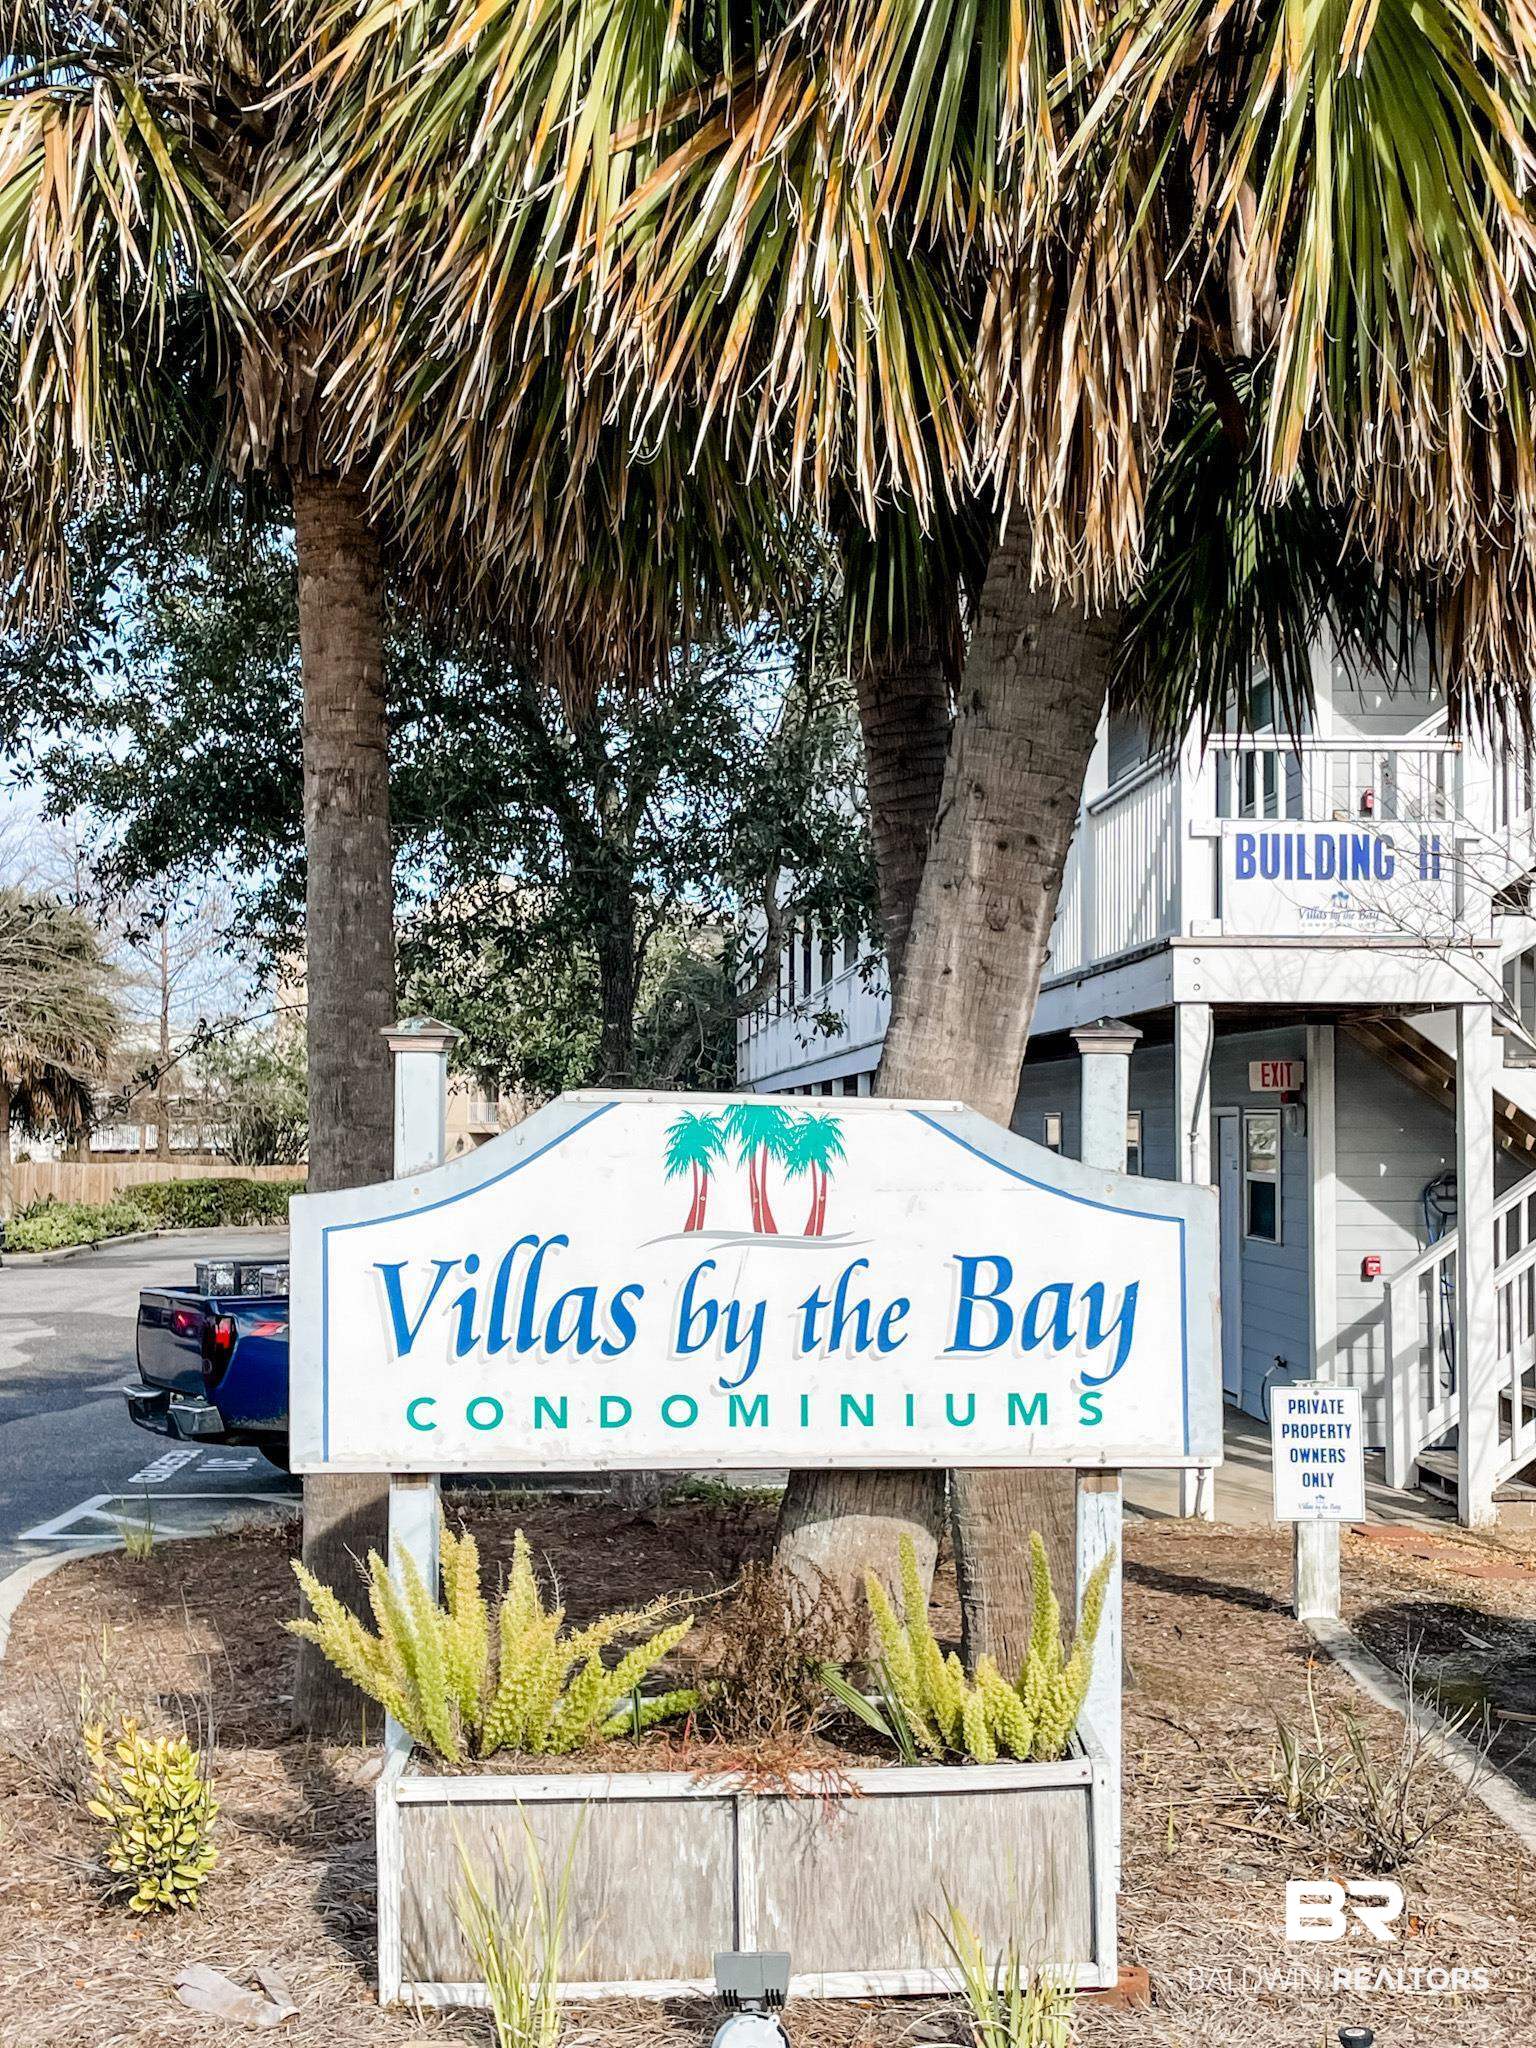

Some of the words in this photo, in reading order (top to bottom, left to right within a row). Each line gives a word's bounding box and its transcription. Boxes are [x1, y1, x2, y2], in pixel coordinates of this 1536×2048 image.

[1235, 833, 1395, 881] BUILDING
[1419, 834, 1440, 881] II
[1261, 1062, 1293, 1088] EXIT
[371, 1233, 645, 1359] Villas
[674, 1259, 768, 1389] by
[797, 1258, 911, 1355] the
[943, 1254, 1140, 1387] Bay
[405, 1391, 1105, 1432] CONDOMINIUMS
[1288, 1399, 1345, 1415] PRIVATE
[1282, 1423, 1352, 1439] PROPERTY
[1290, 1448, 1346, 1463] OWNERS
[1302, 1472, 1335, 1488] ONLY
